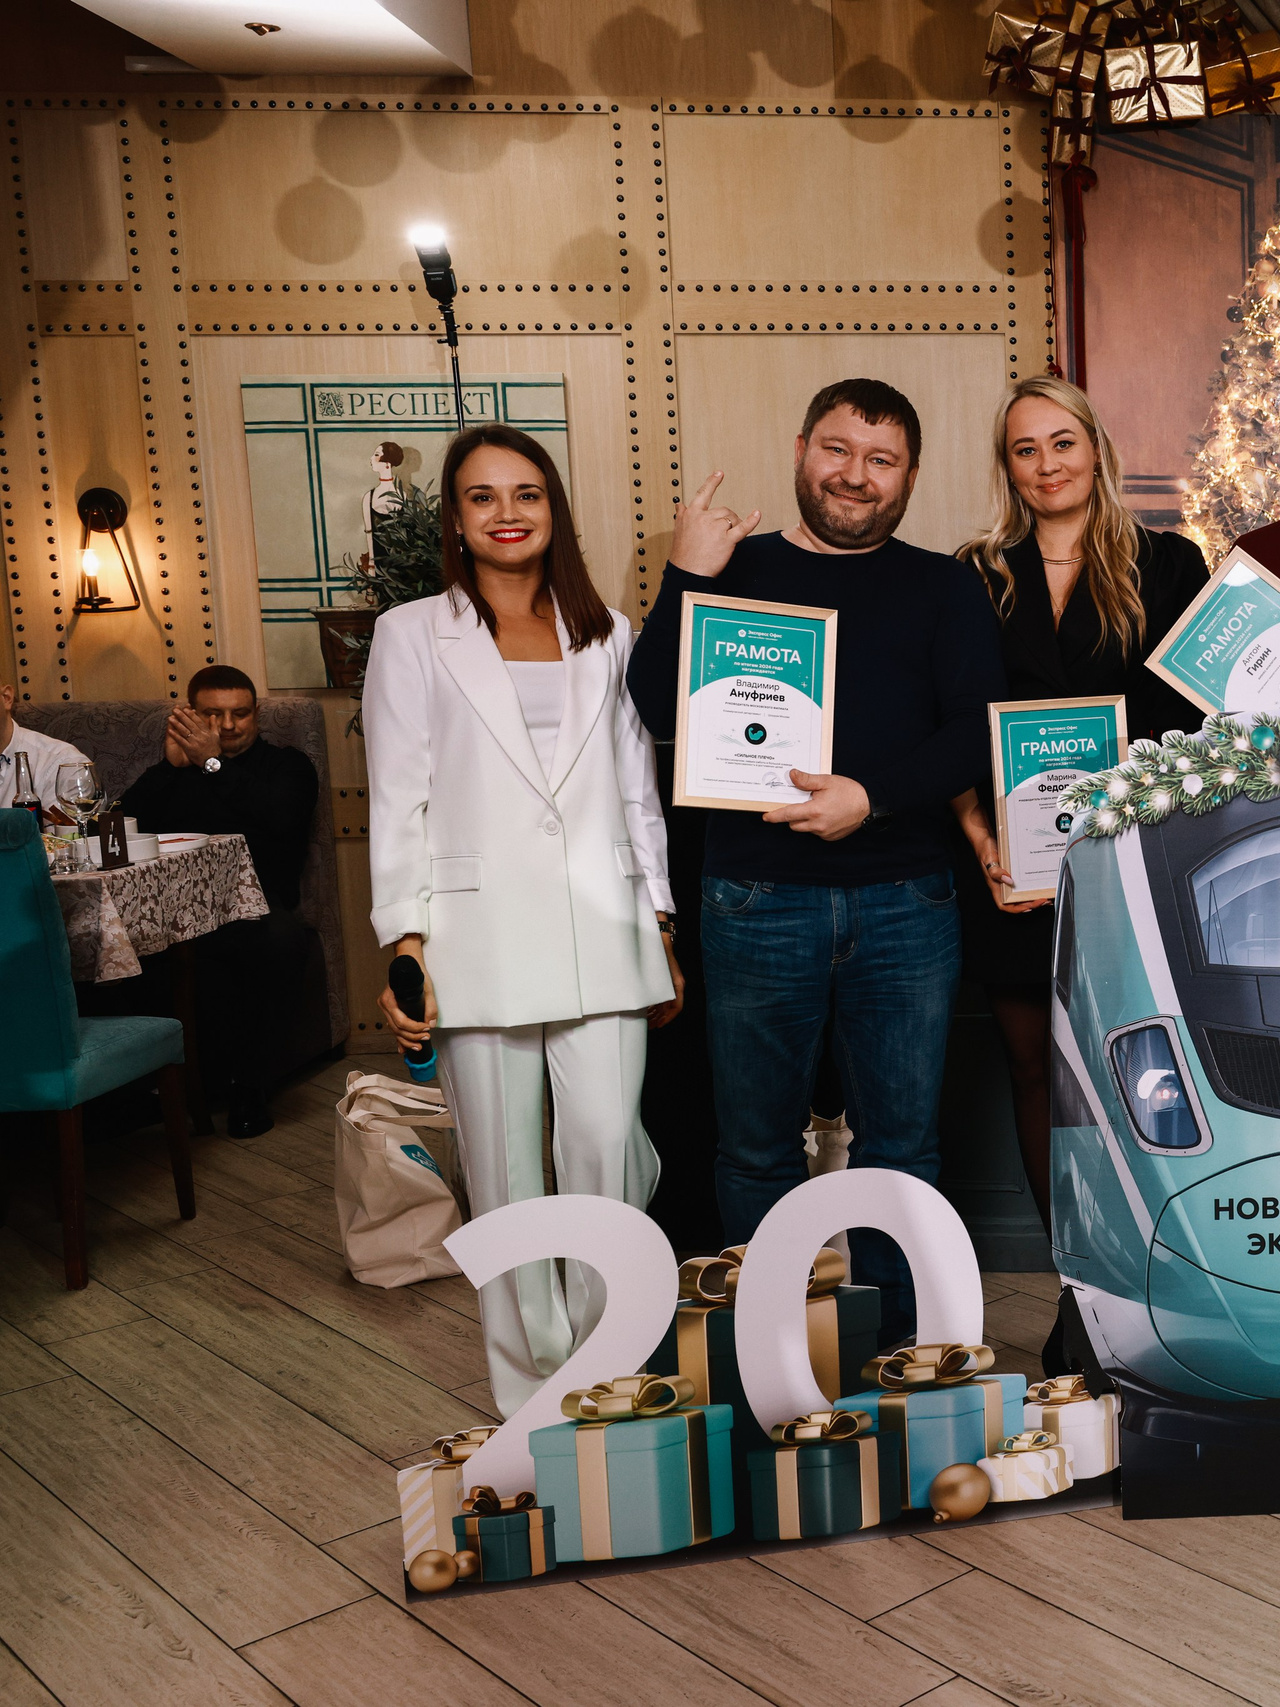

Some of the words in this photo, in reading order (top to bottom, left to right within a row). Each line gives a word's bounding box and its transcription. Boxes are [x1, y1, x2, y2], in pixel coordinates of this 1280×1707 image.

[748, 630, 769, 638] Экспресс
[1195, 601, 1258, 672] ГРАМОТА
[715, 641, 802, 665] ГРАМОТА
[1242, 644, 1261, 666] Антон
[1246, 647, 1272, 676] Гирин
[730, 688, 785, 702] Ануфриев
[736, 679, 780, 692] Владимир
[1020, 738, 1098, 756] ГРАМОТА
[1047, 773, 1076, 782] Марина
[1038, 783, 1070, 793] Федор
[108, 833, 121, 857] 4
[442, 1167, 984, 1497] 20
